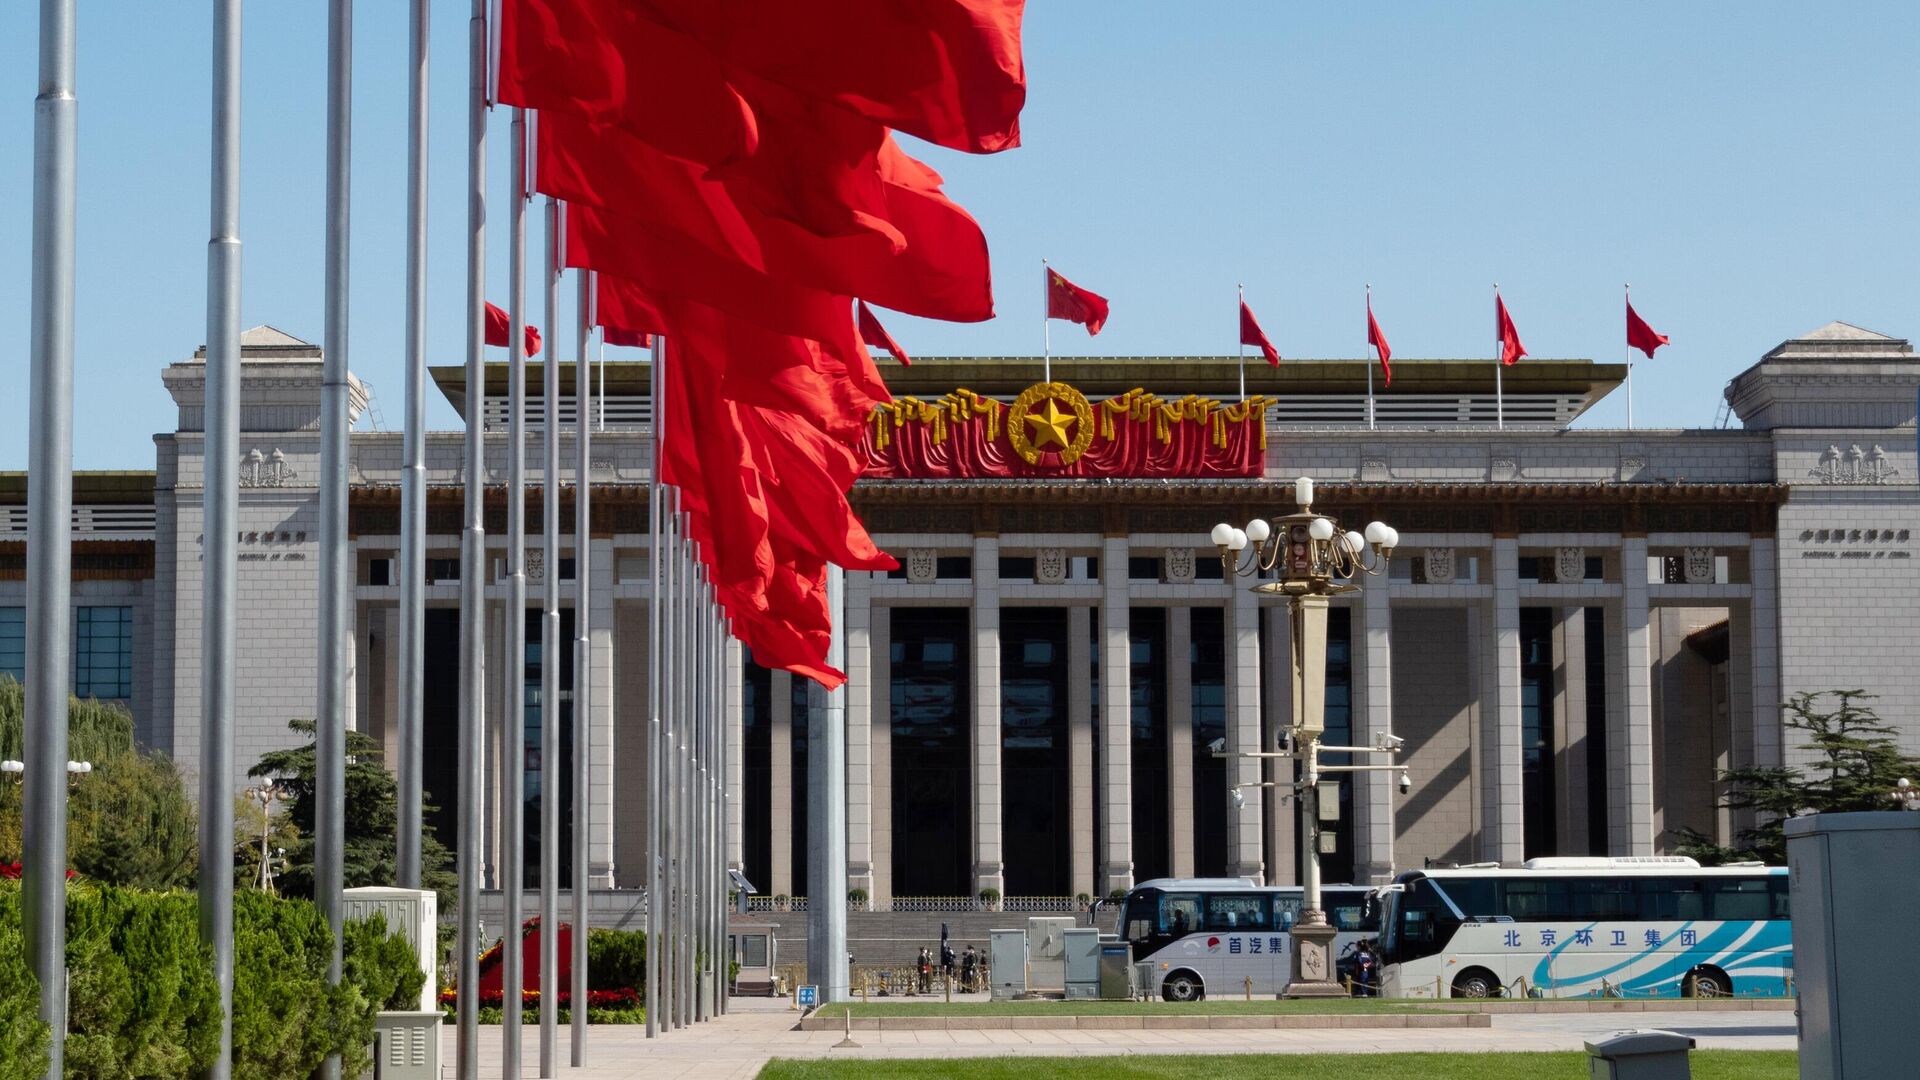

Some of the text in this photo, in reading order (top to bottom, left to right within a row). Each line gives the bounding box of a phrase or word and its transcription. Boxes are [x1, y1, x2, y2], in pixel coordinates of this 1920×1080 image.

[1229, 937, 1292, 954] 首汽集
[1503, 929, 1697, 947] 北京环卫集团
